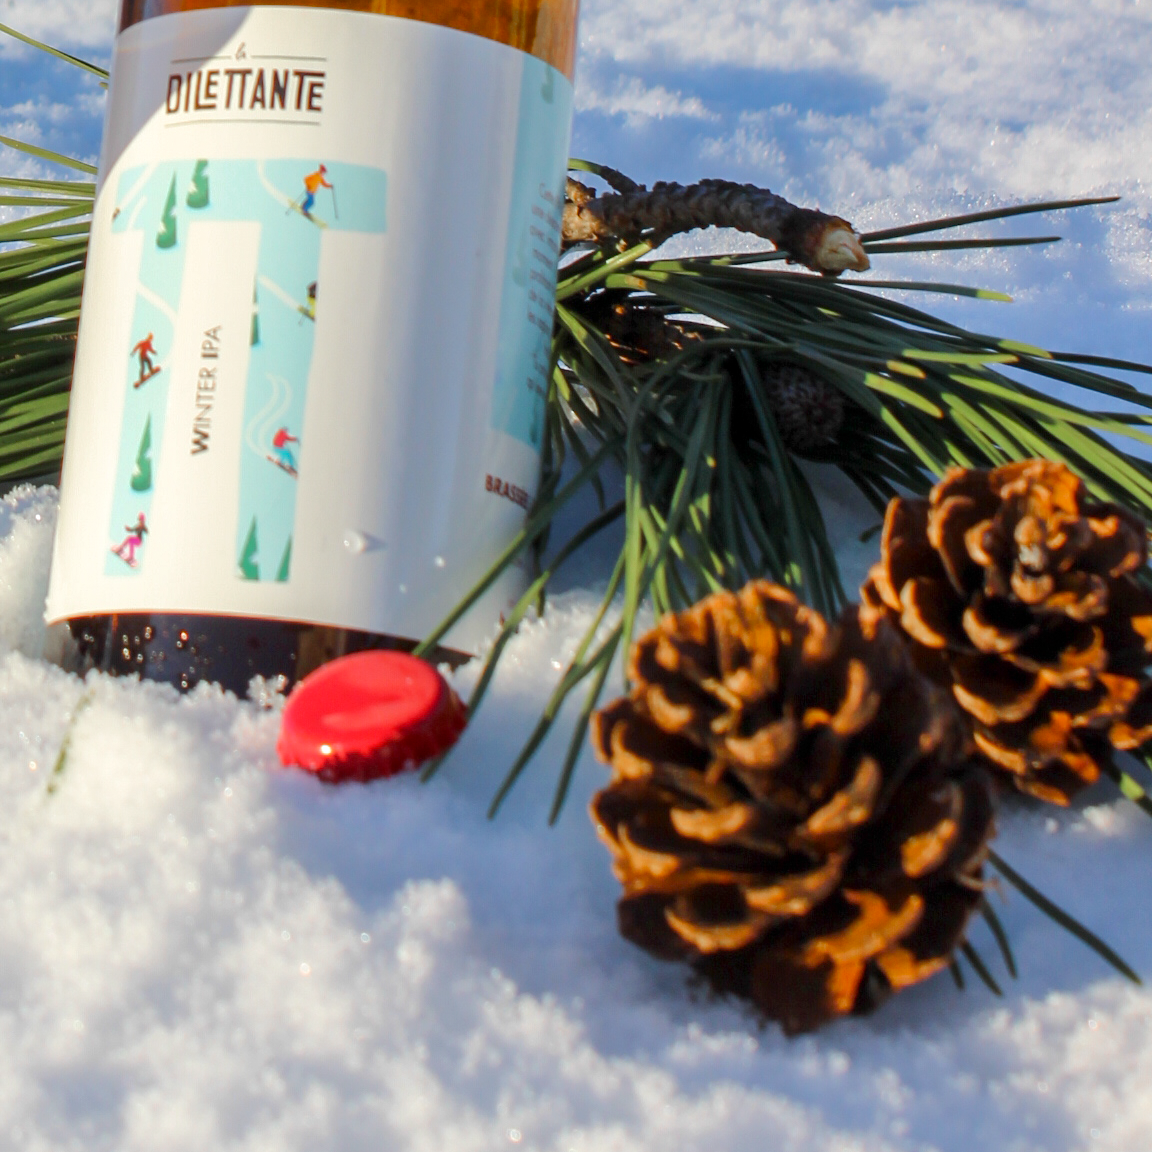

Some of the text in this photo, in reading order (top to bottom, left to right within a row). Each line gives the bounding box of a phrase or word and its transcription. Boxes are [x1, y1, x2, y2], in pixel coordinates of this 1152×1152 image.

[165, 68, 326, 114] DILETTANTE
[190, 325, 222, 456] WINTER IPA
